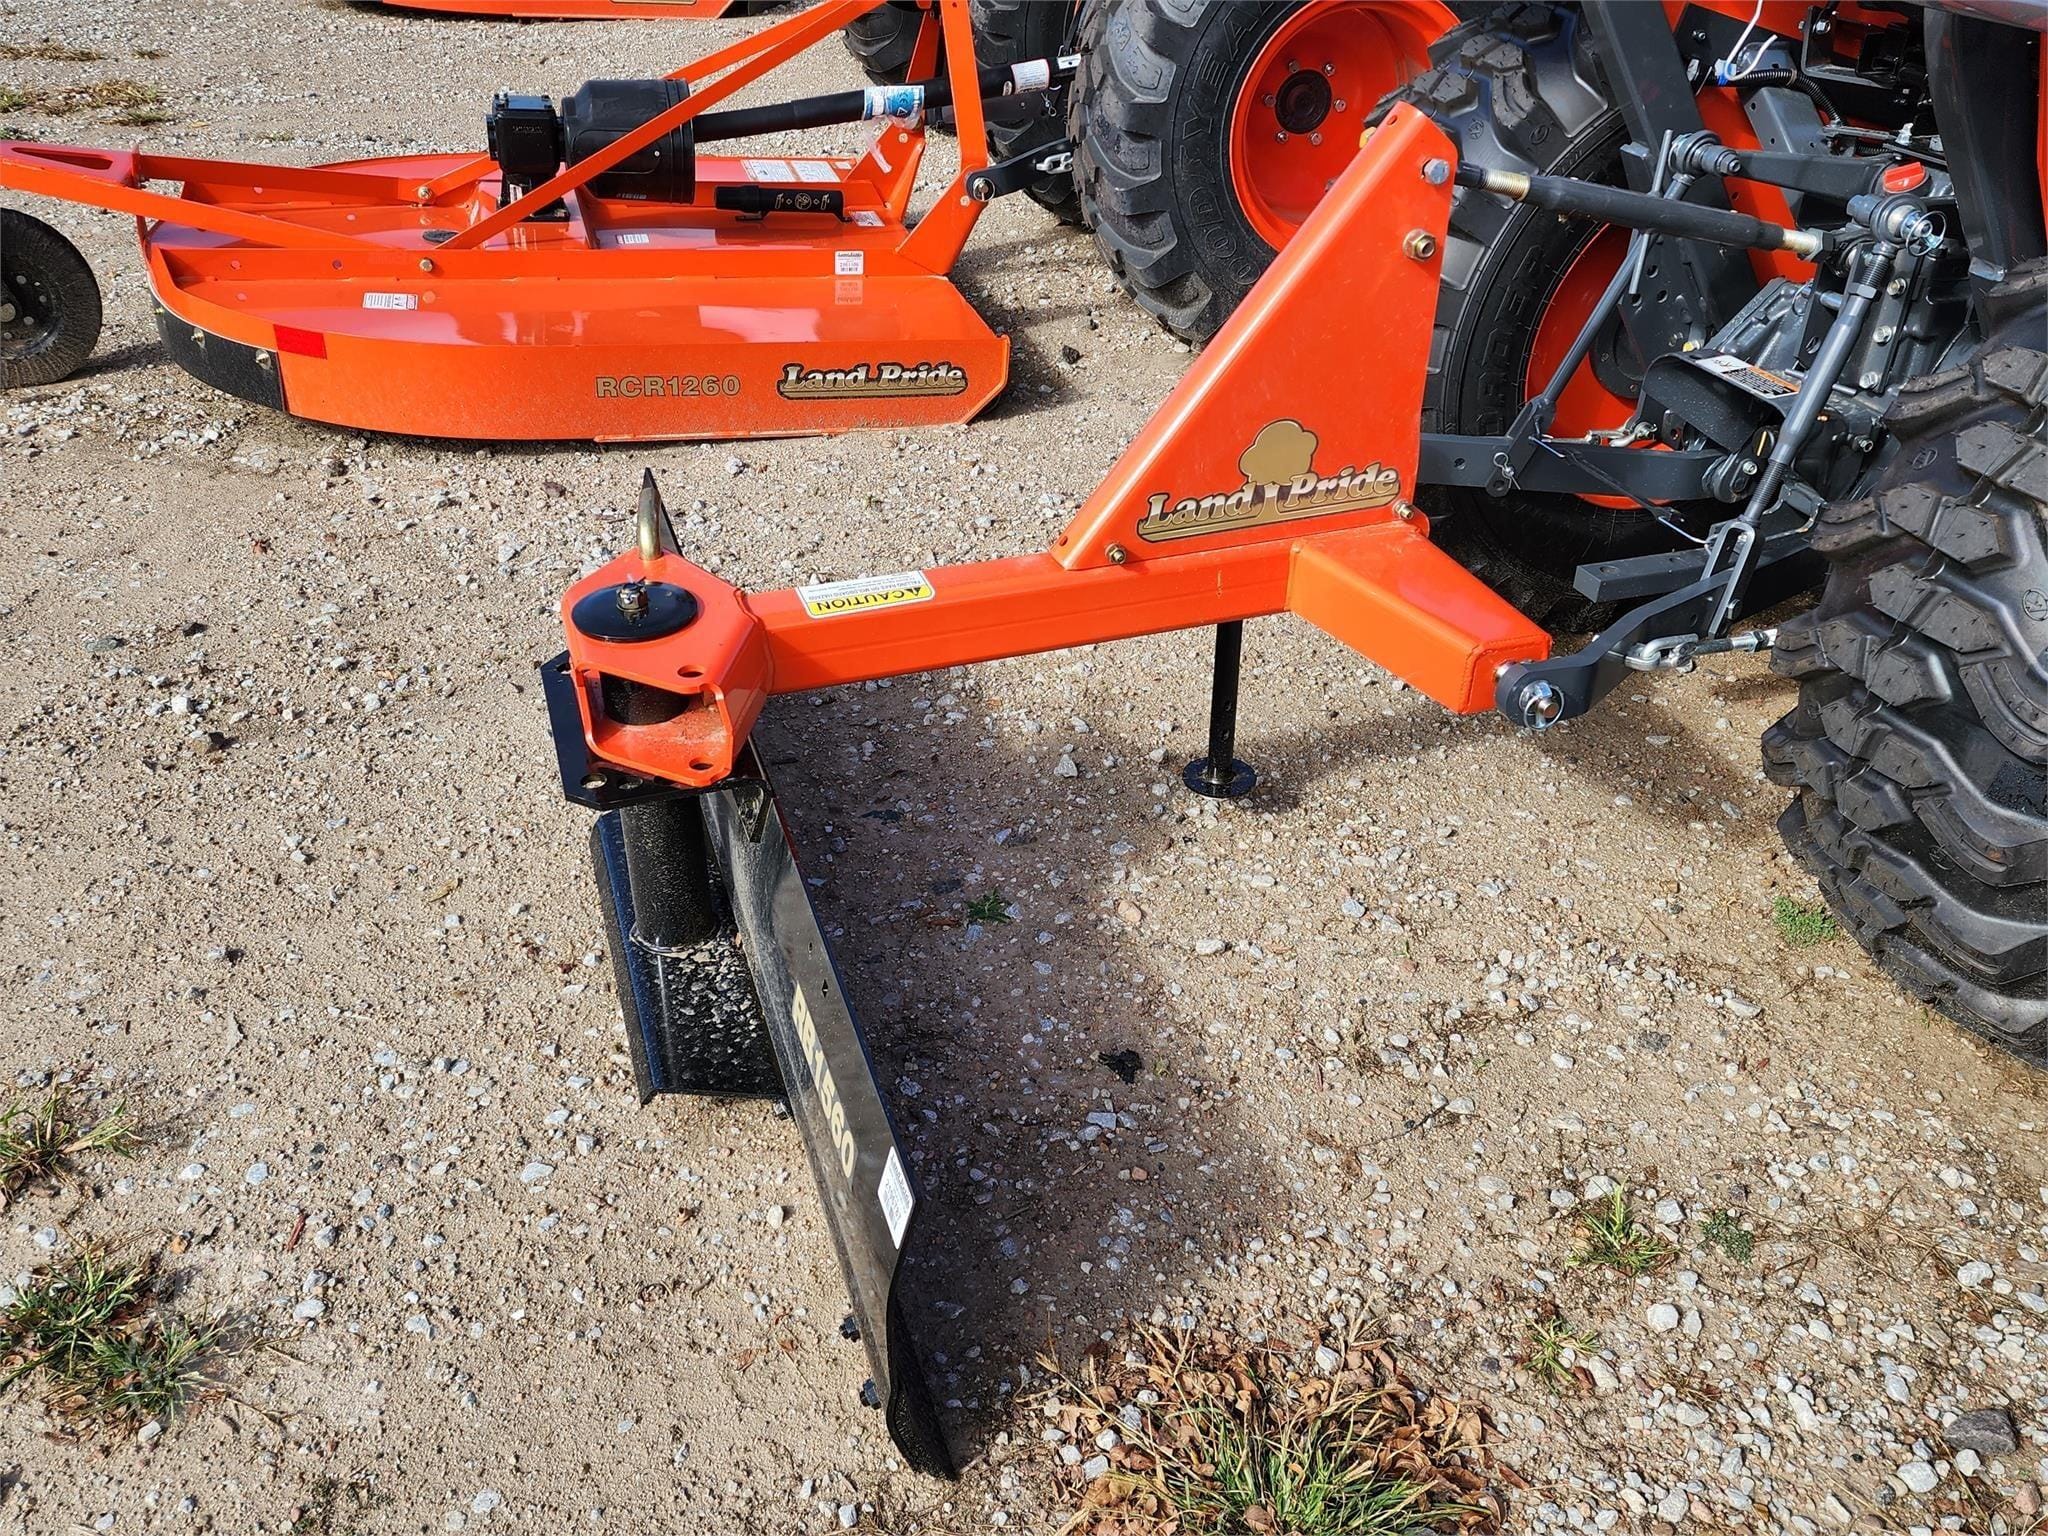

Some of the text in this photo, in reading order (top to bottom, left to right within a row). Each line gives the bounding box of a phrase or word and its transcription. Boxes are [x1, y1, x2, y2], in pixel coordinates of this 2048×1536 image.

[595, 375, 741, 398] RCR1260
[782, 363, 966, 391] Land Pride
[1142, 462, 1400, 530] Land Pride
[816, 589, 905, 611] CAUTION
[791, 983, 856, 1178] RB1560
